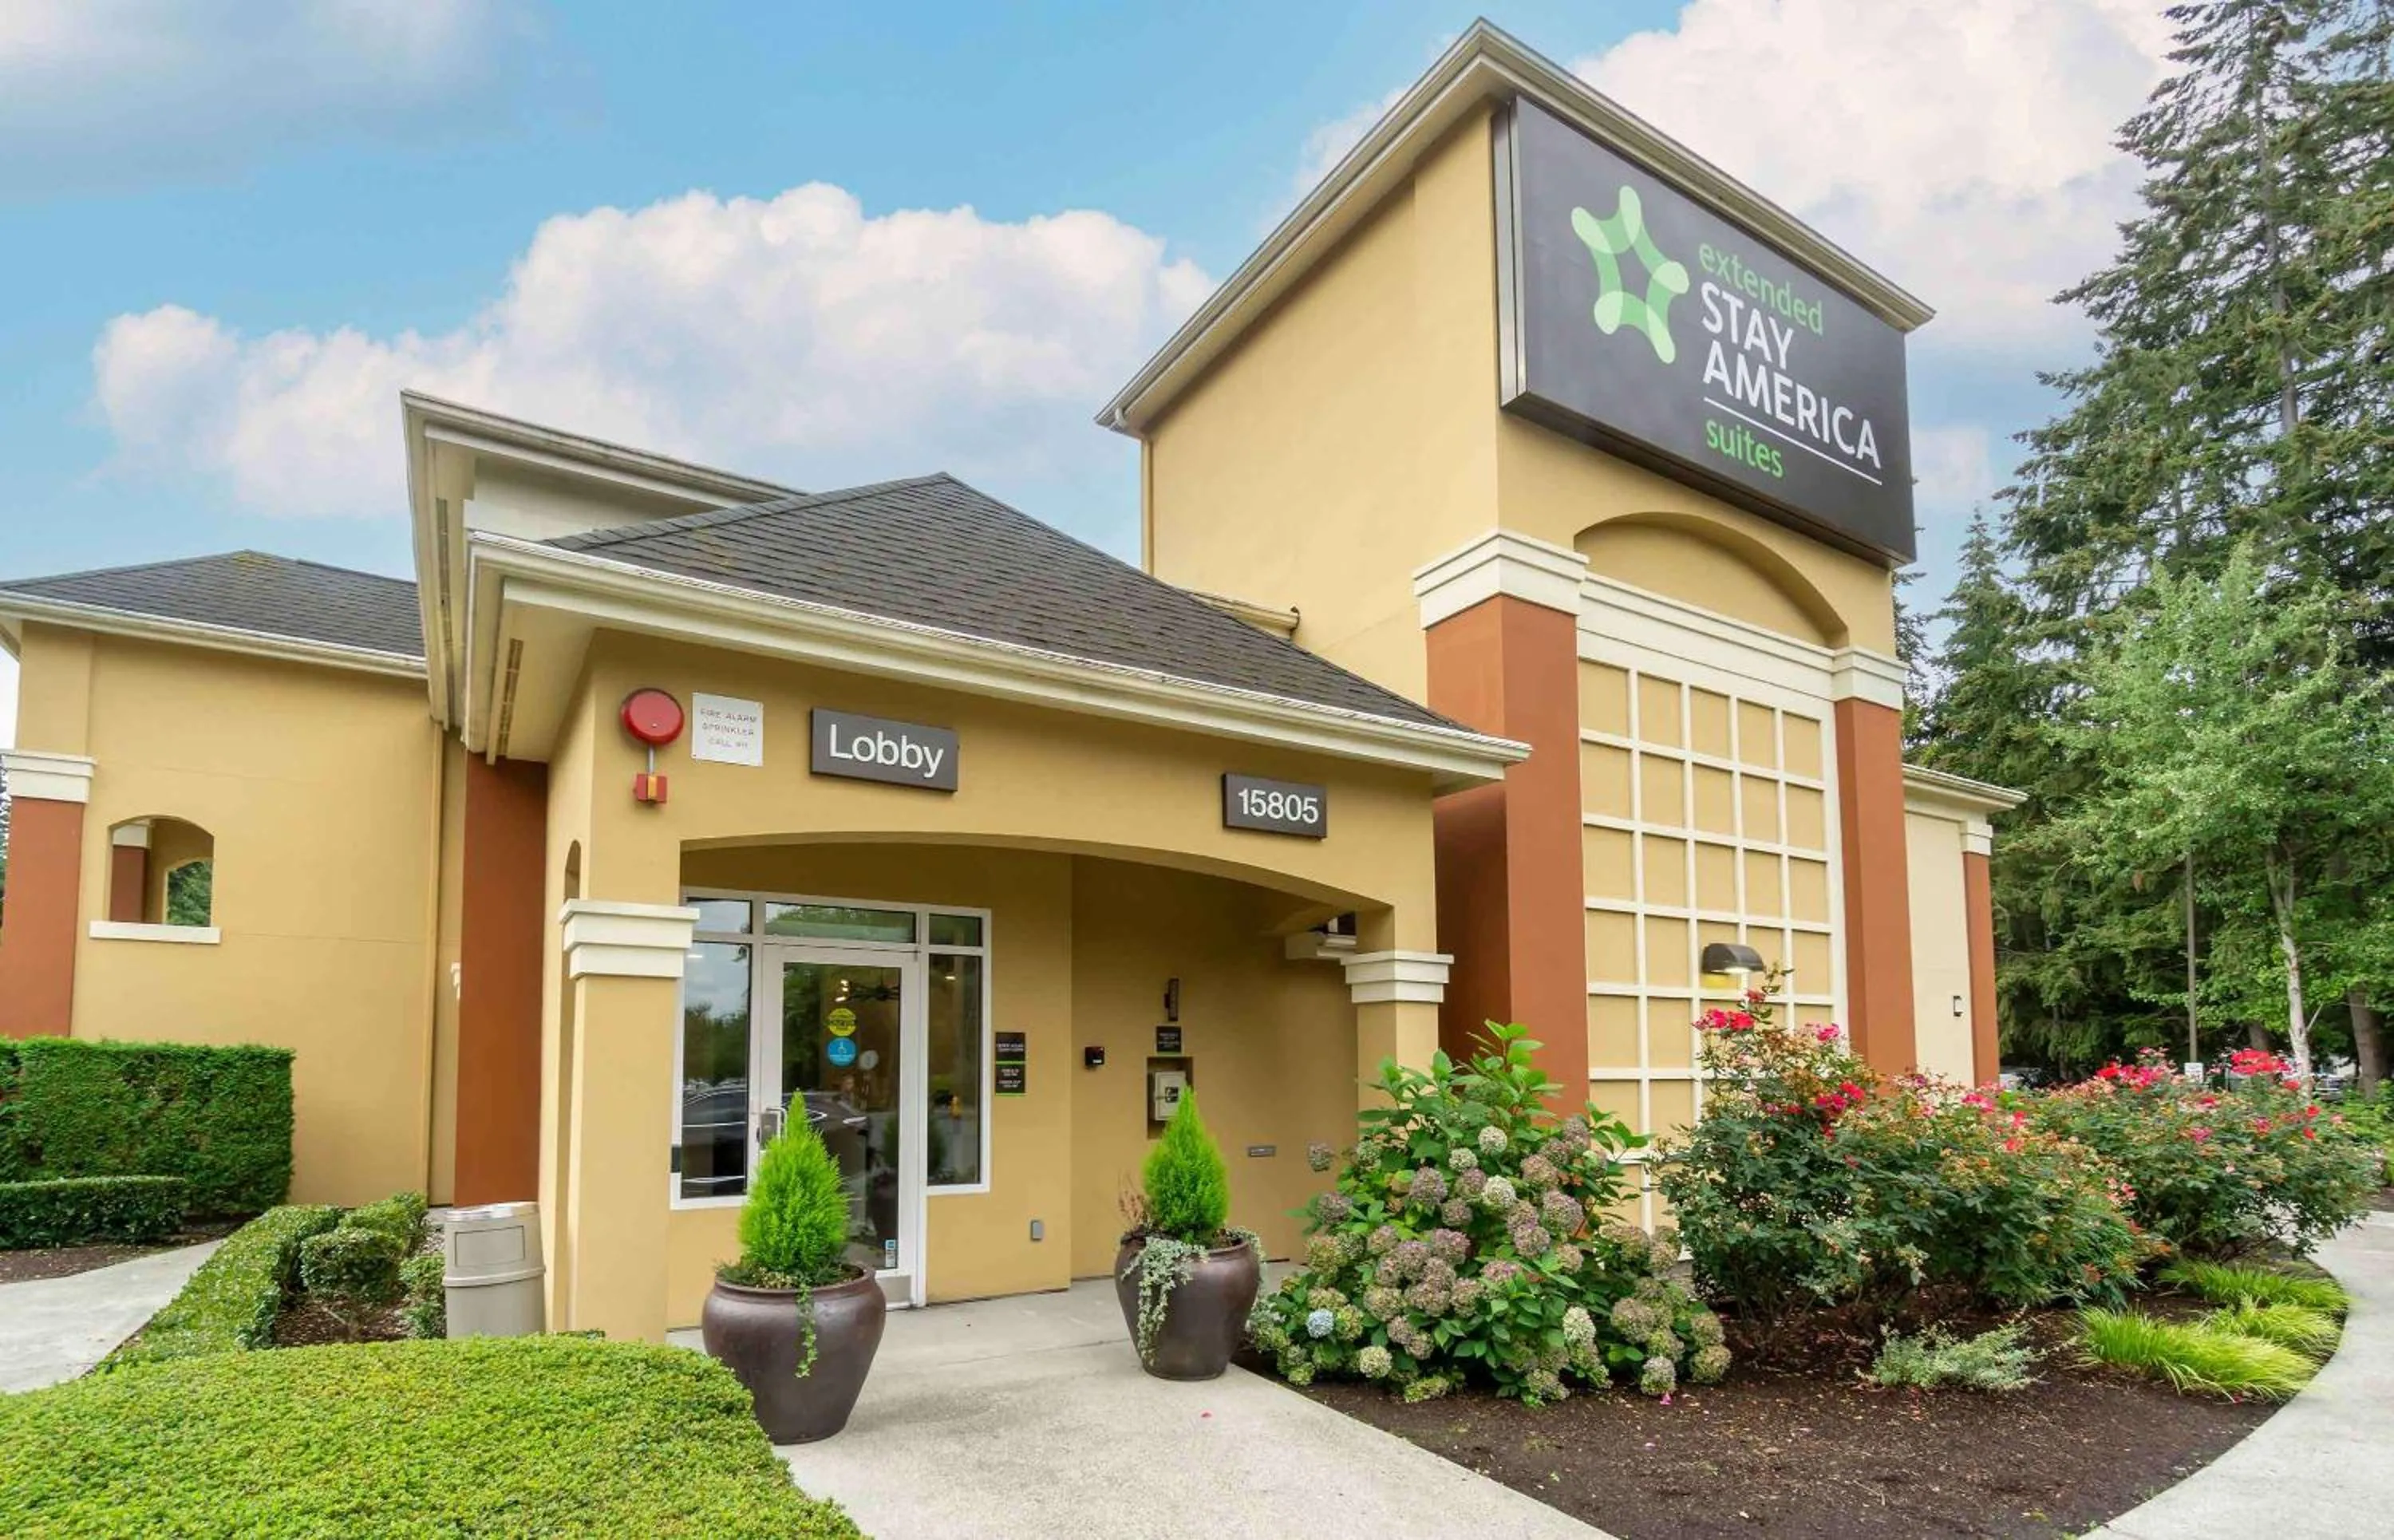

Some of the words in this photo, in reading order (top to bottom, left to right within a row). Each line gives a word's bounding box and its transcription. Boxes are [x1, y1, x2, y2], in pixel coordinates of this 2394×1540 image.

[1699, 243, 1823, 334] extended
[1701, 282, 1794, 369] STAY
[1702, 341, 1881, 469] AMERICA
[1706, 421, 1784, 477] suites
[829, 724, 944, 778] Lobby
[1238, 788, 1319, 823] 15805
